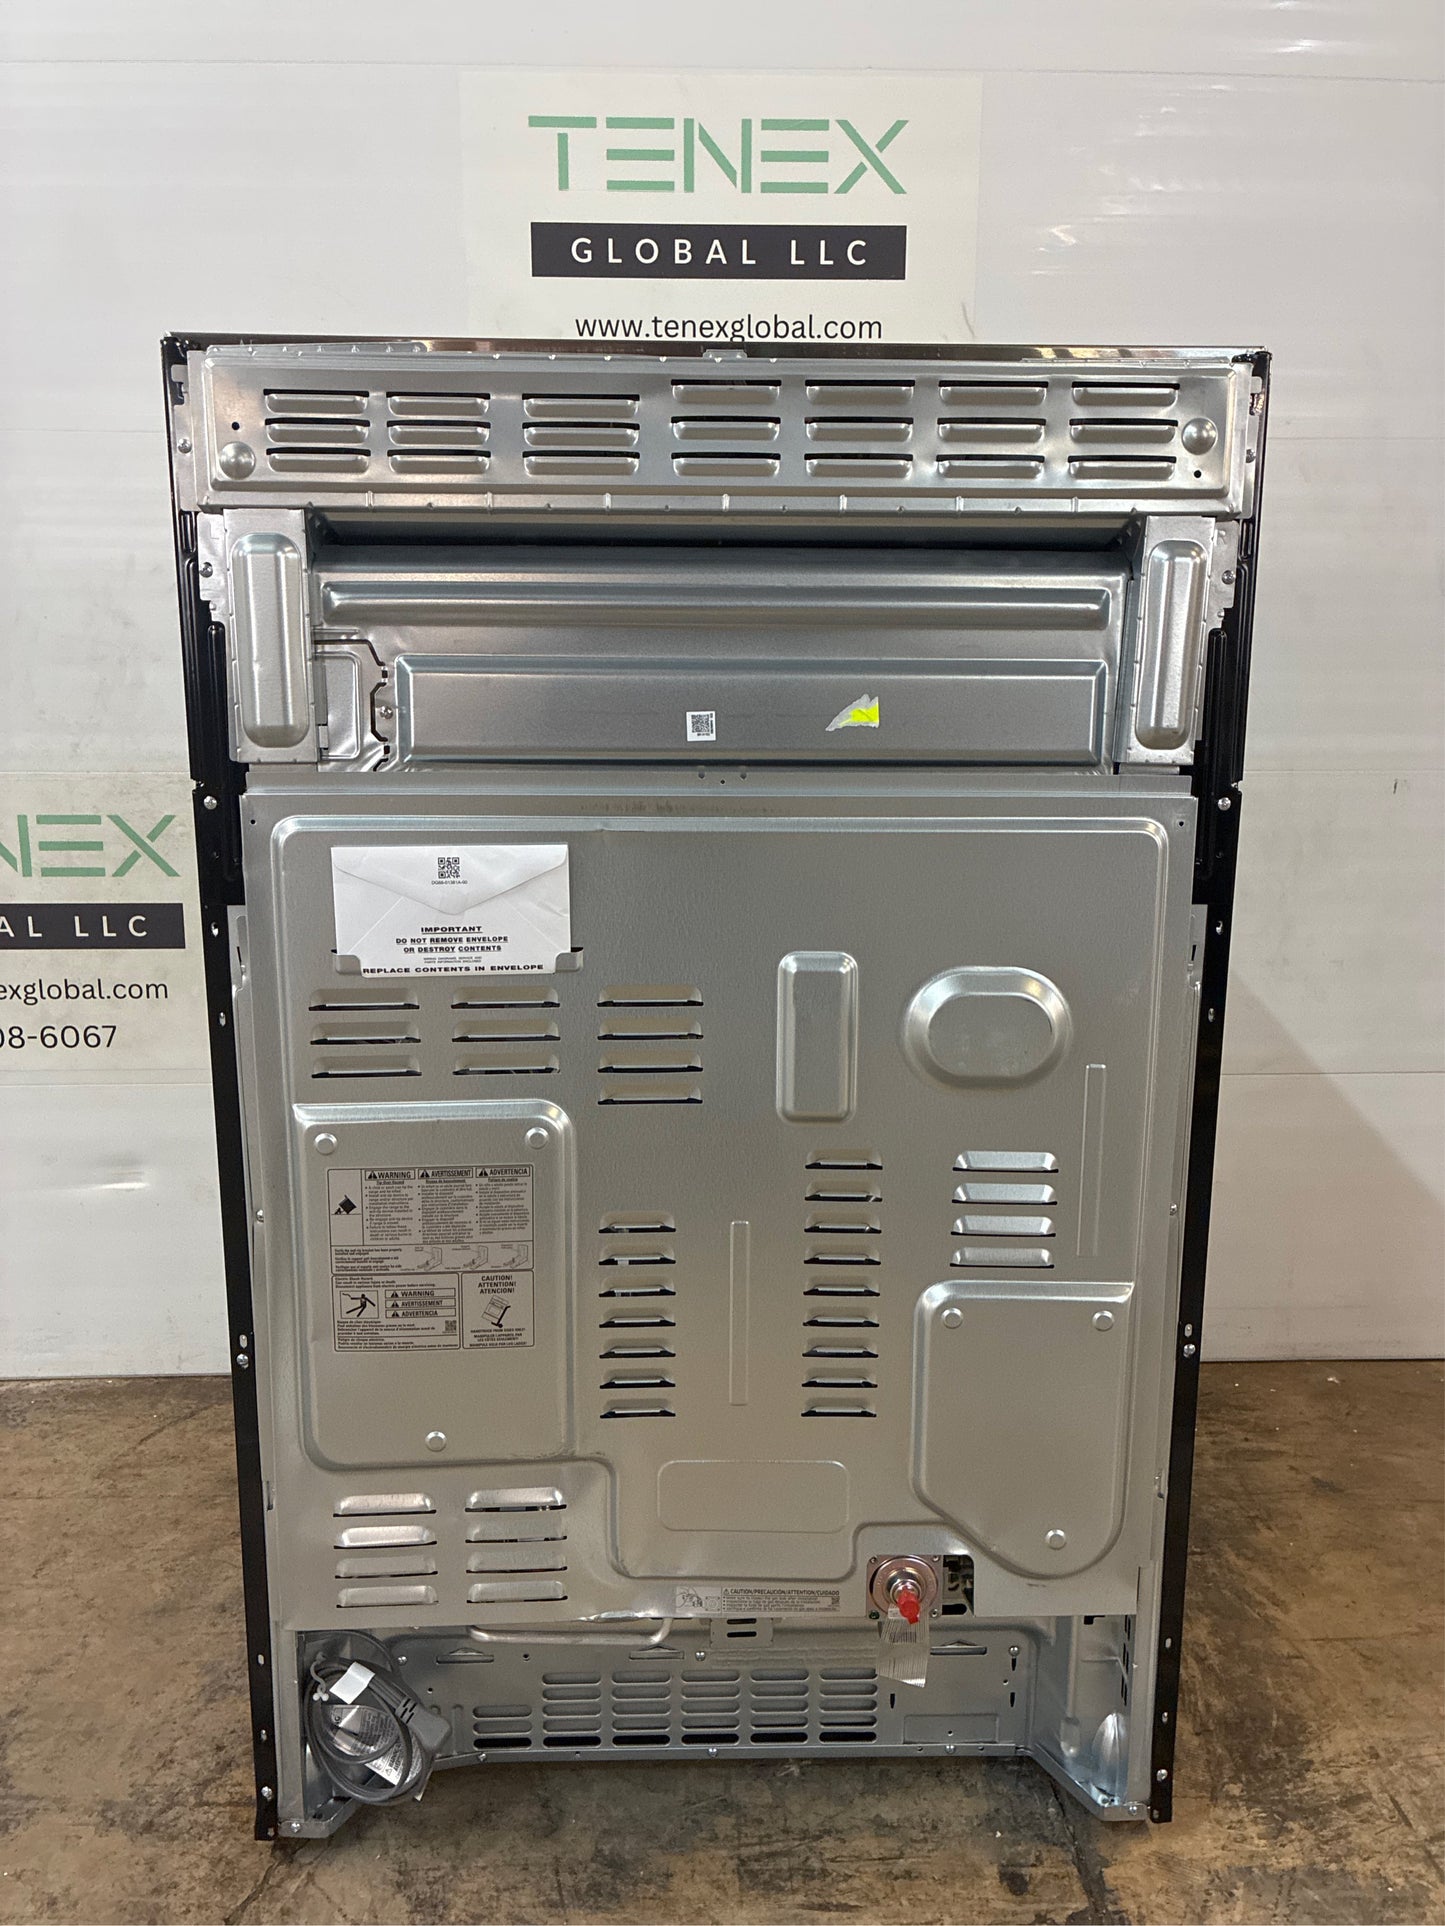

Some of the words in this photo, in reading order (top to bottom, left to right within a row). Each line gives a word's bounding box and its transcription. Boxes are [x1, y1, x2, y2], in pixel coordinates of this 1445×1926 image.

[528, 115, 910, 194] TENEX
[570, 237, 757, 265] GLOBAL
[789, 238, 869, 266] LLC
[574, 314, 882, 342] www.tenexglobal.com
[74, 915, 148, 937] LLC
[420, 925, 483, 934] IMPORTANT
[430, 936, 463, 944] REMOVE
[378, 1171, 411, 1179] WARNING
[431, 1169, 471, 1177] AVERTISSEMENT
[489, 1168, 528, 1176] ADVERTENCIA
